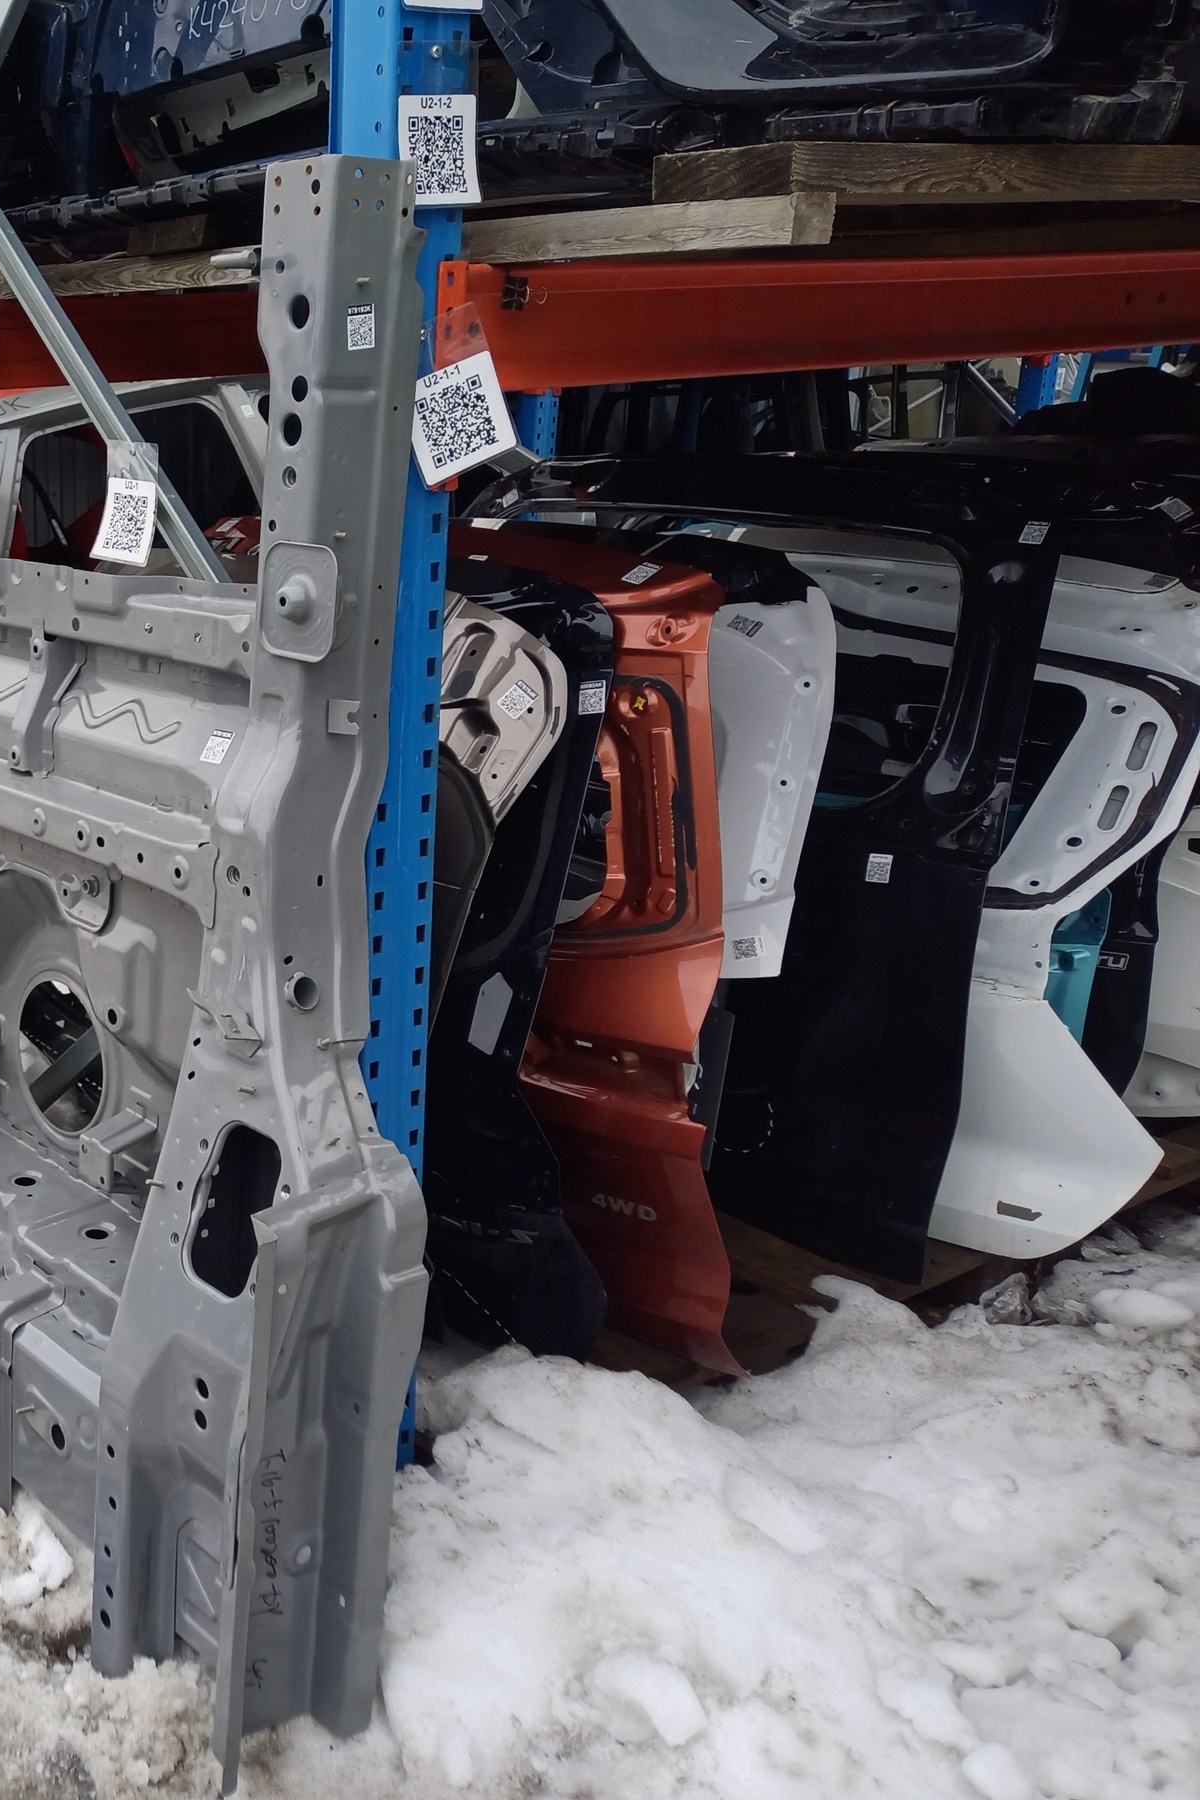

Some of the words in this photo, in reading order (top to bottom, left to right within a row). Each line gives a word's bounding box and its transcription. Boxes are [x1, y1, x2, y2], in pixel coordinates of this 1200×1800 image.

[420, 97, 452, 109] U2-1-2
[423, 364, 461, 389] U2-1-1
[125, 480, 139, 491] U2-1
[591, 1193, 658, 1223] 4WD
